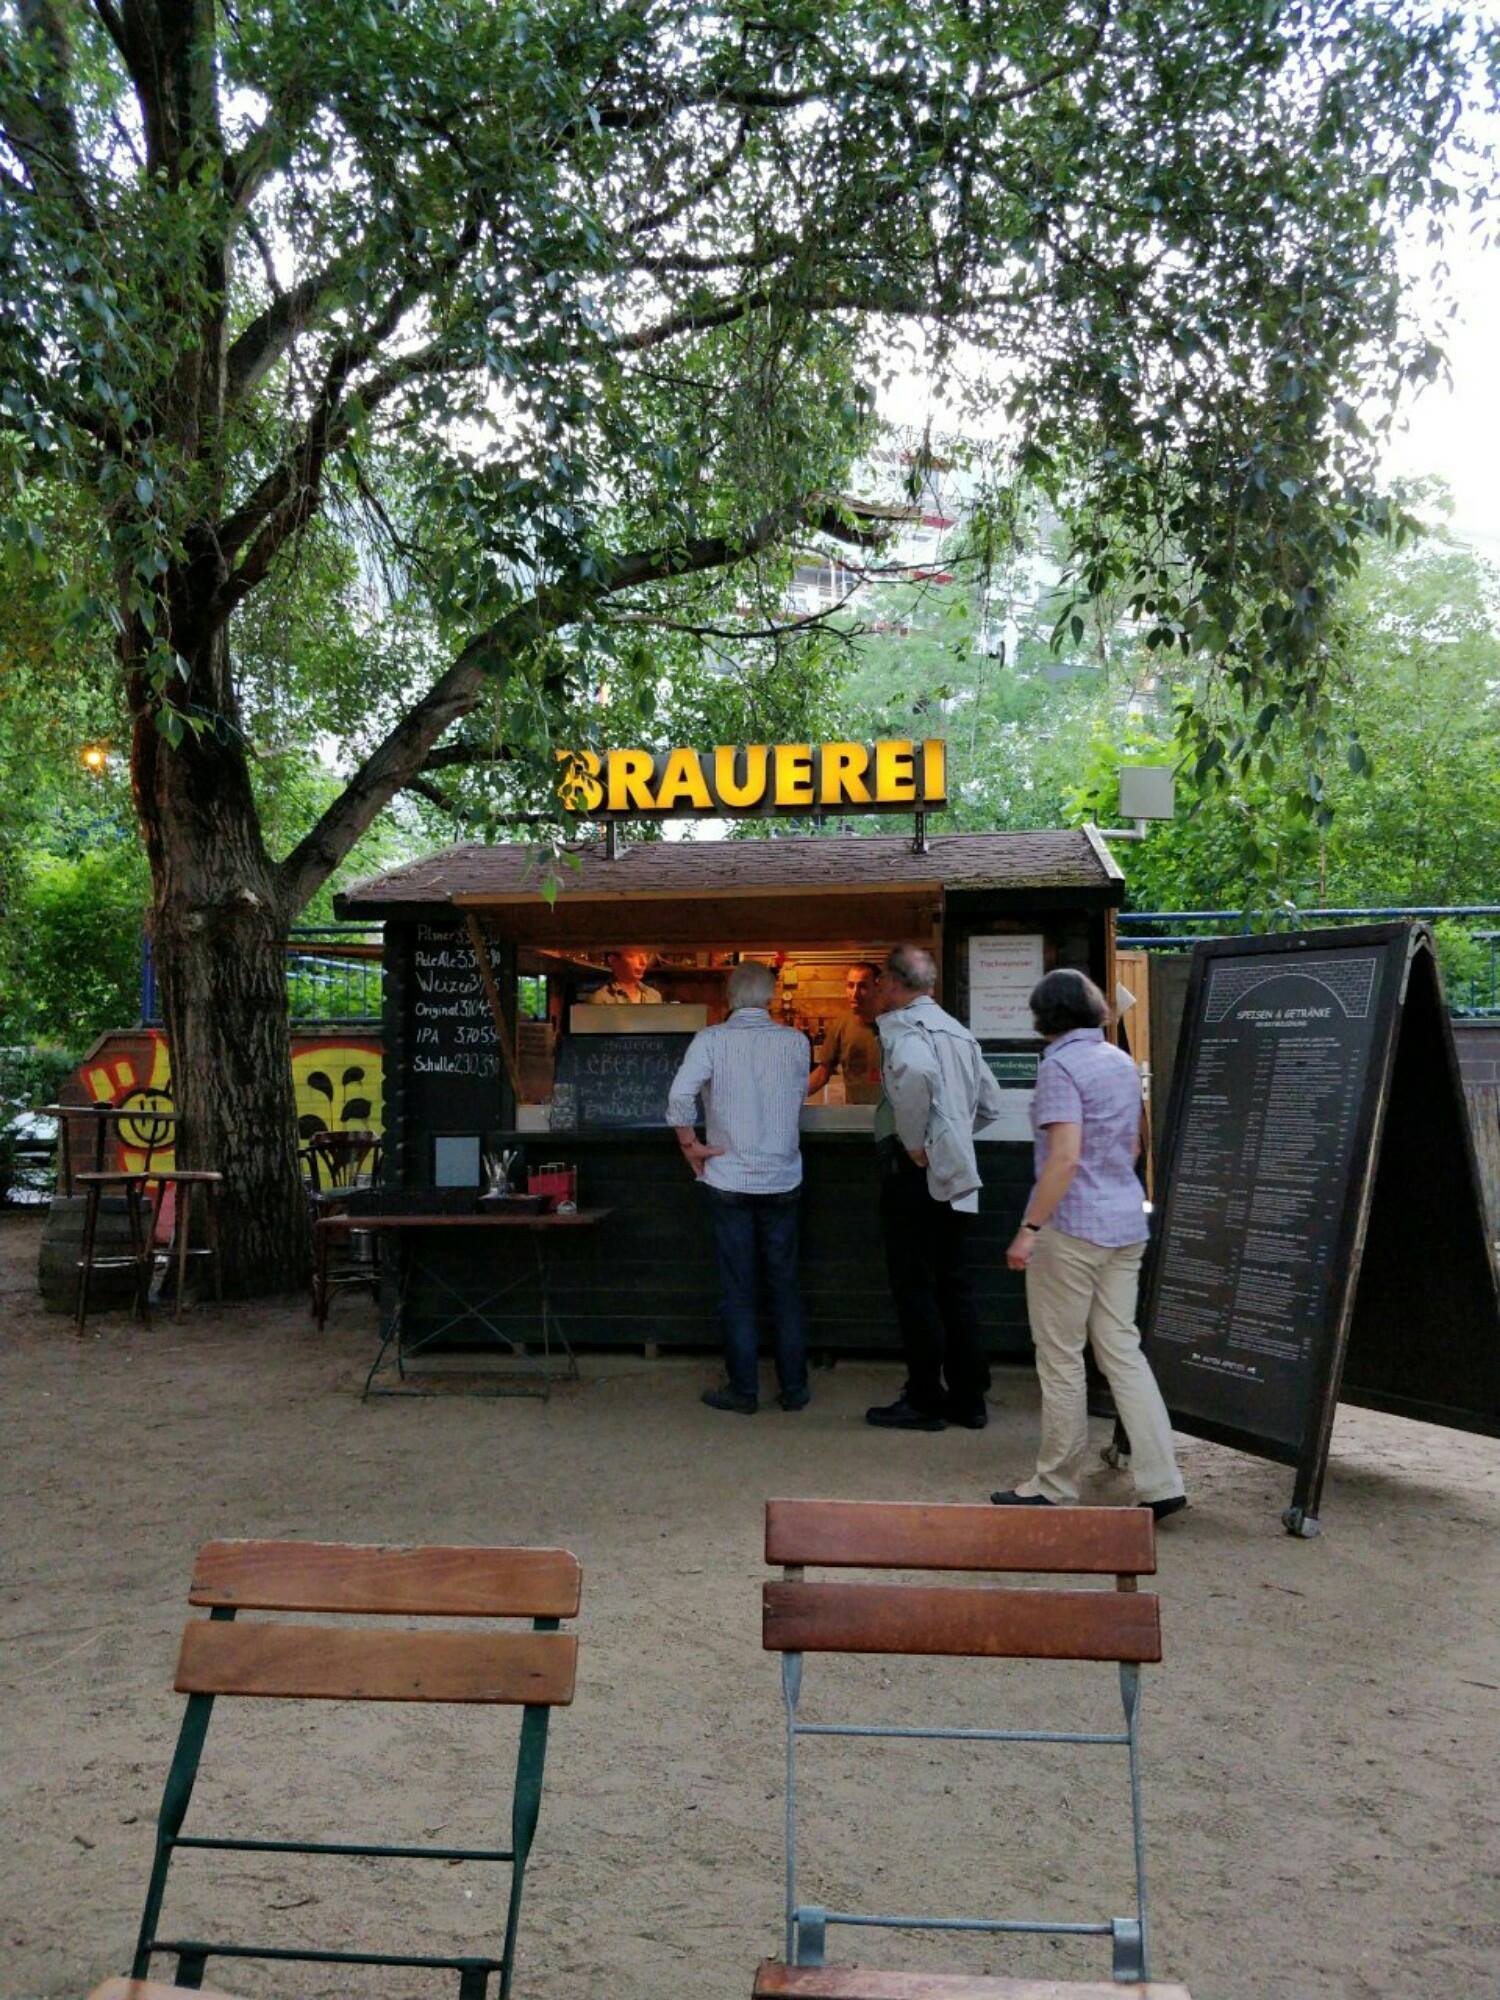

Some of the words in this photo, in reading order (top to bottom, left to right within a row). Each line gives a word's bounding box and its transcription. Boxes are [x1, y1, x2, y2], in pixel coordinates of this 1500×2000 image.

[556, 739, 947, 811] BRAUEREI
[415, 969, 473, 994] Weizen
[415, 1002, 459, 1019] Original
[1236, 1009, 1273, 1020] SPEISEN
[1284, 1006, 1332, 1019] GETRÄNKE
[416, 1028, 439, 1044] IPA
